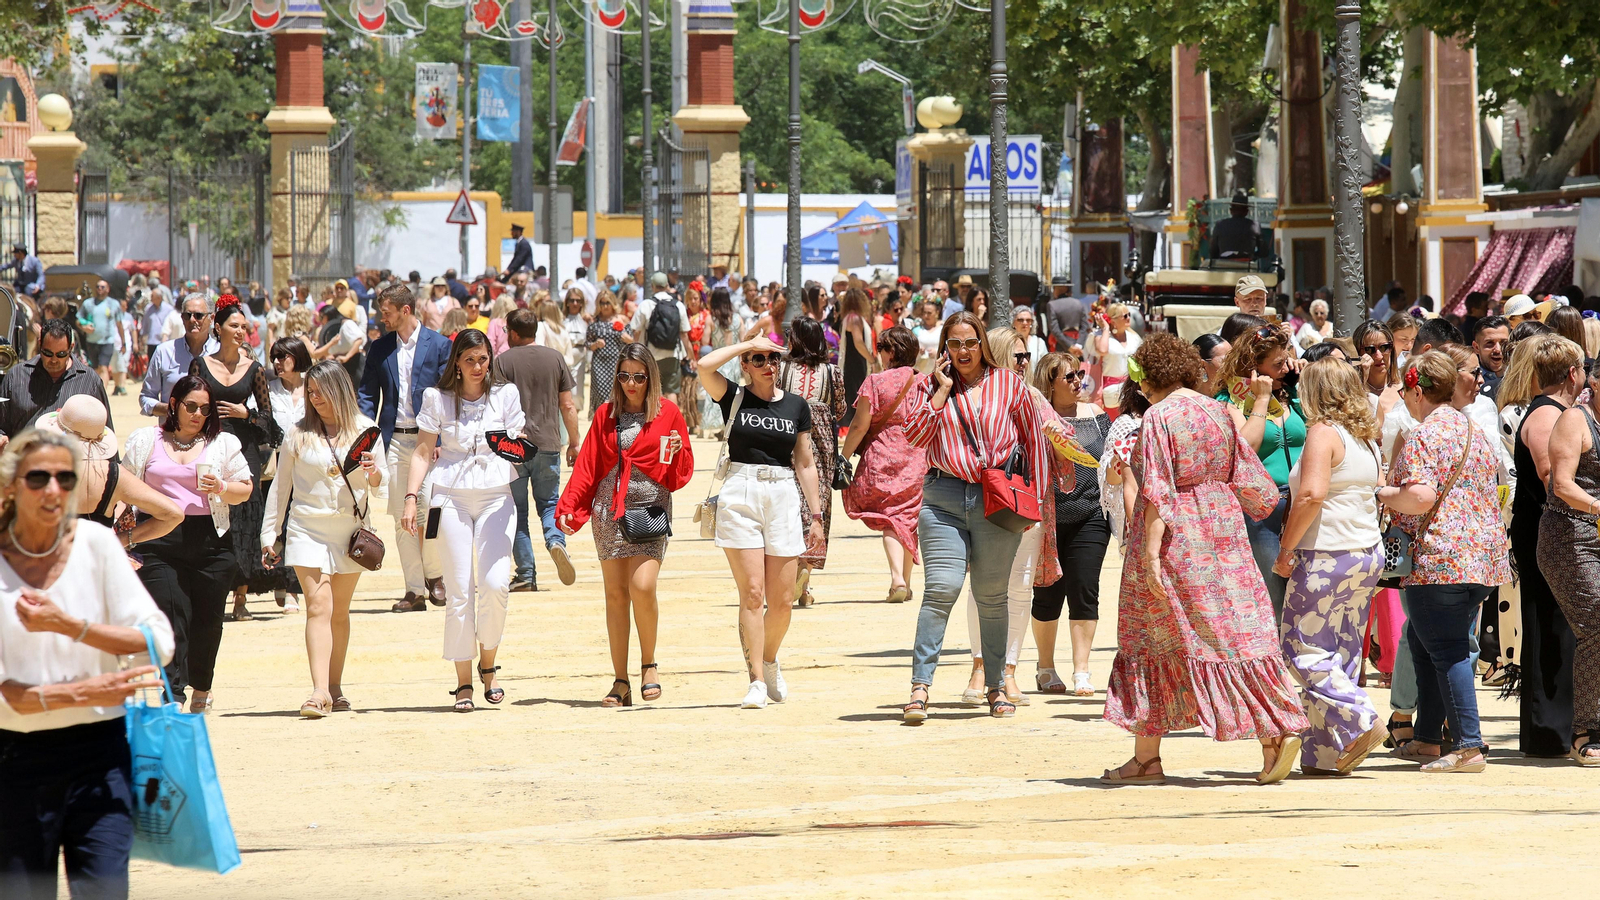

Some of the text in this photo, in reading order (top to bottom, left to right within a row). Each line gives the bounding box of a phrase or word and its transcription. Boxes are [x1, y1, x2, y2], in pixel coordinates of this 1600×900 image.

[480, 97, 504, 108] ERES
[479, 107, 509, 118] FERIA
[967, 142, 1037, 181] AOS
[741, 412, 794, 434] VOGUE
